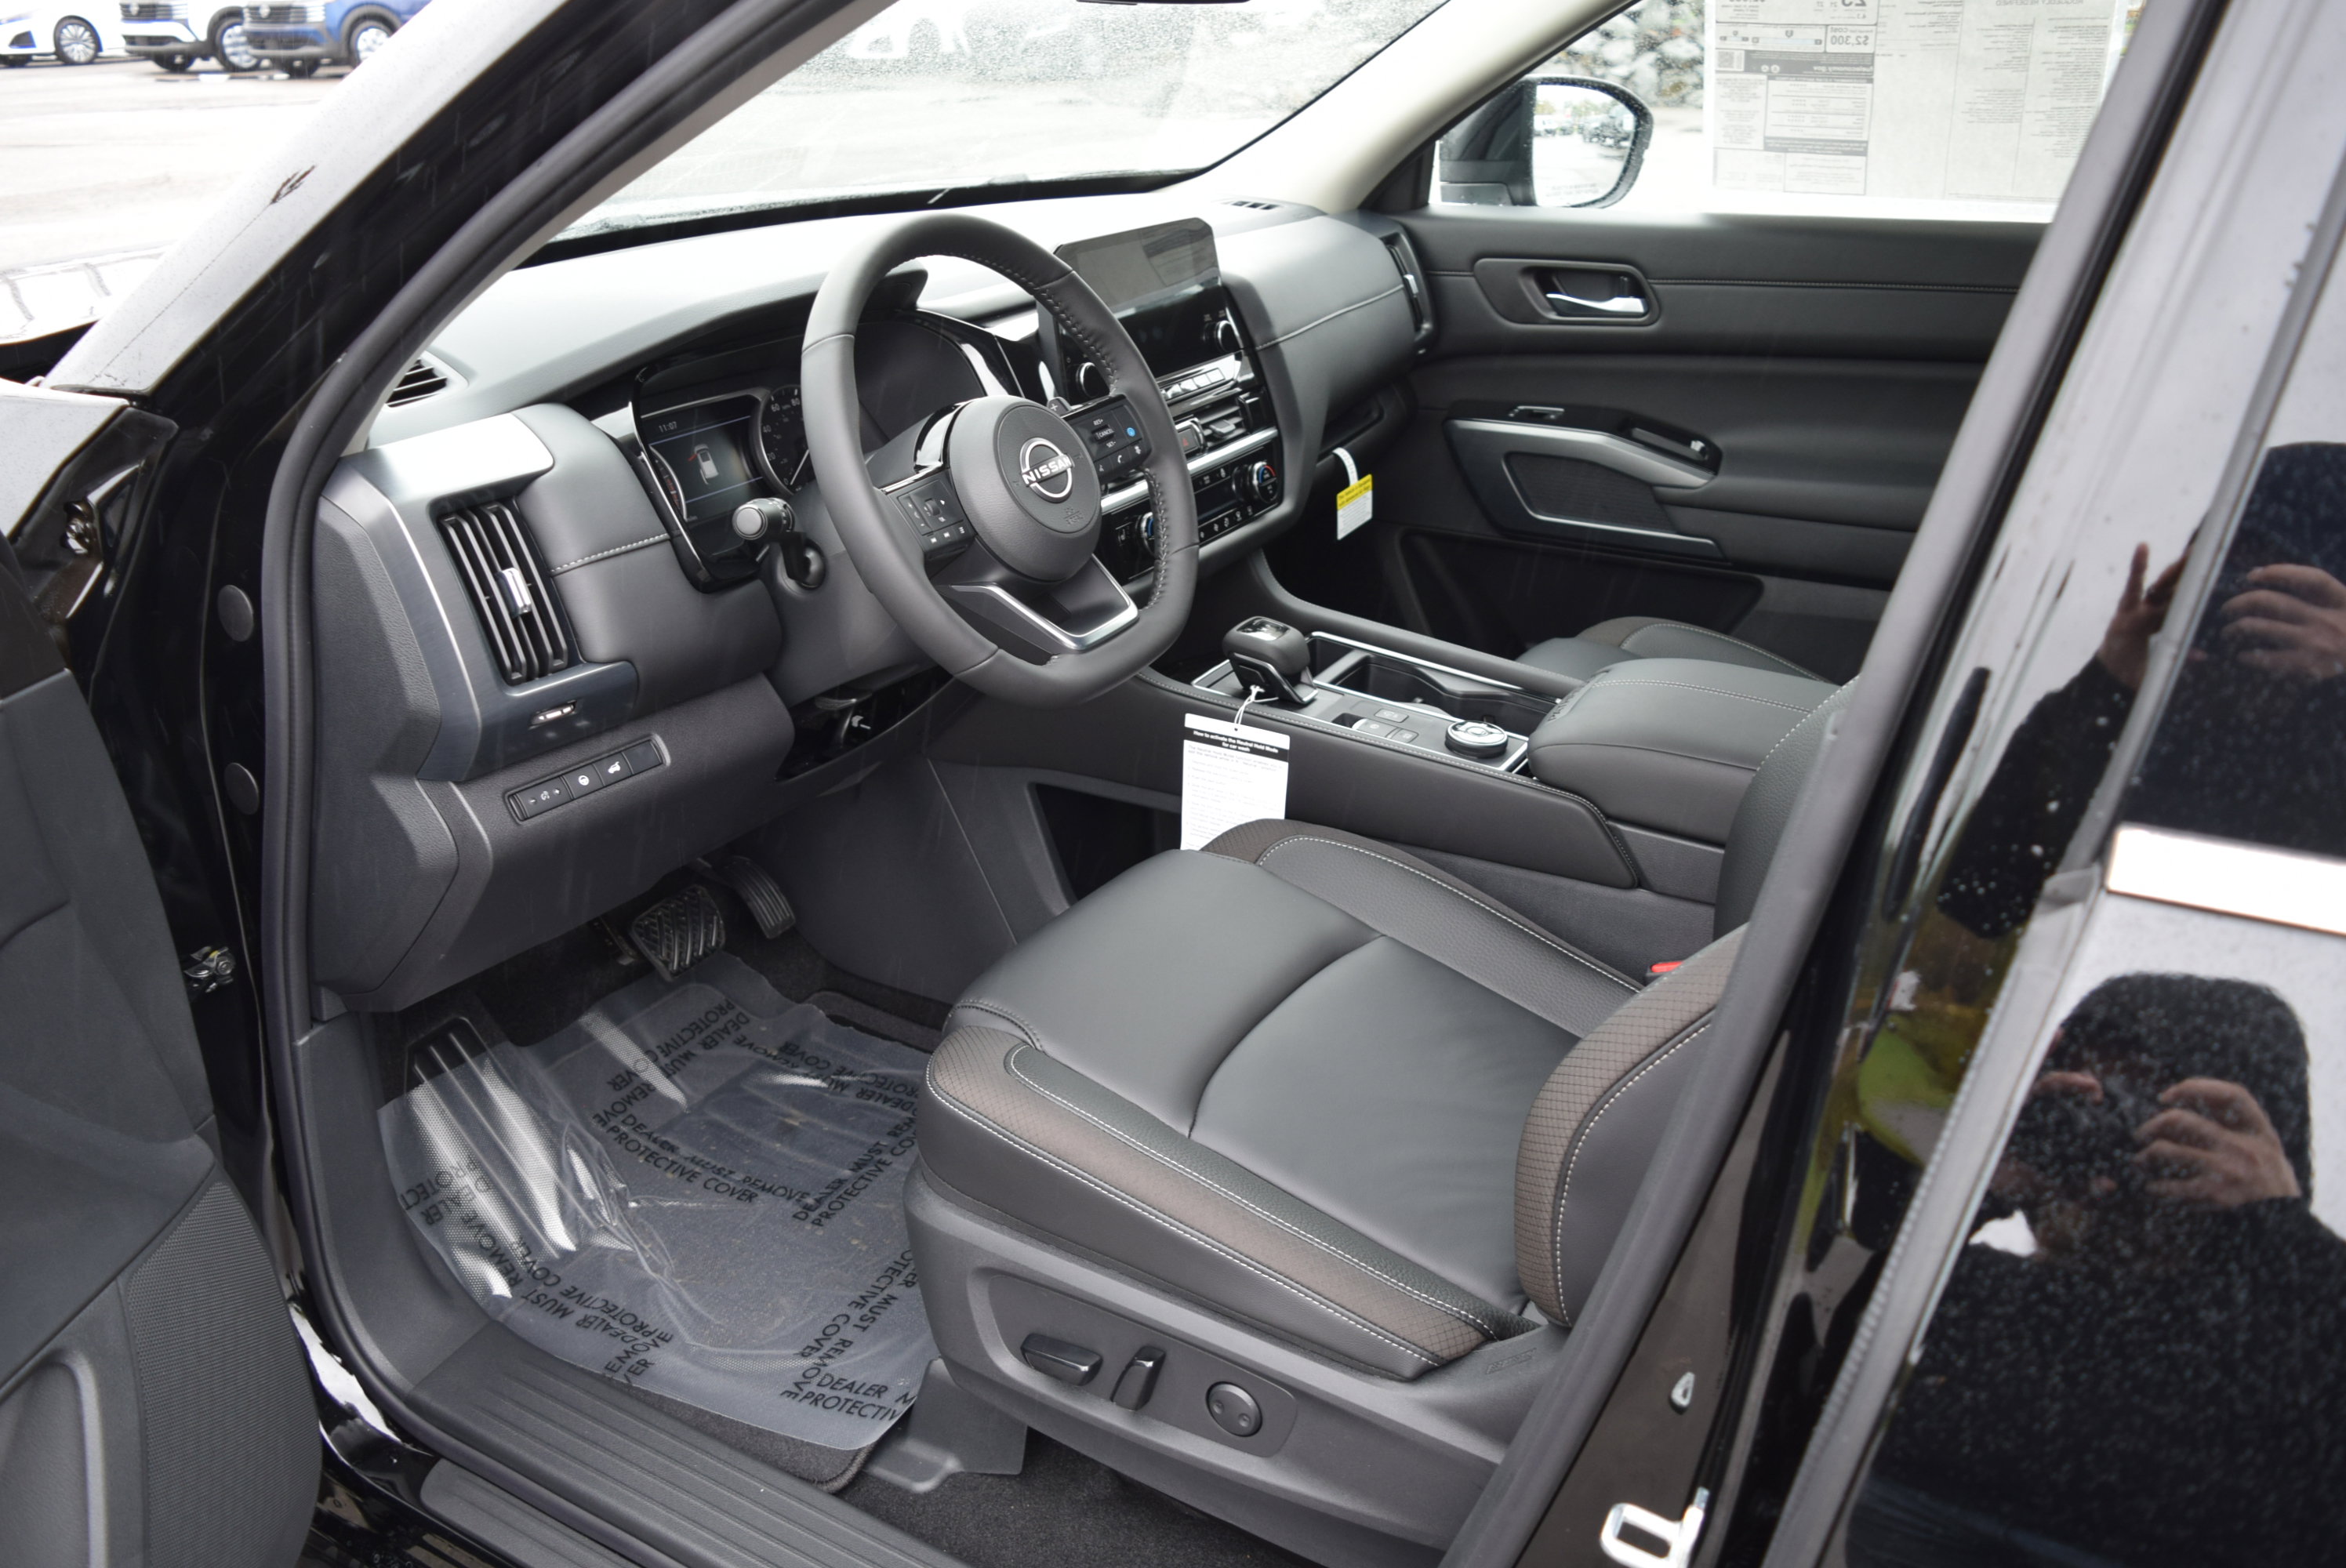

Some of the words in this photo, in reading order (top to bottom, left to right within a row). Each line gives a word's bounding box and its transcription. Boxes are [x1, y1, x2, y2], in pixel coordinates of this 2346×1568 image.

[771, 403, 780, 412] 60
[659, 422, 677, 433] 11:07
[1022, 457, 1071, 484] NISSAN
[1237, 739, 1254, 748] Neutral
[656, 998, 735, 1058] PROTECTIVE
[698, 1011, 750, 1051] DEALER
[607, 1049, 659, 1091] COVER
[779, 1040, 831, 1071] COVER
[592, 1082, 656, 1127] REMOVE
[855, 1087, 917, 1112] DEALER
[606, 1125, 703, 1183] PROTECTIVE
[703, 1178, 758, 1203] COVER
[621, 1114, 681, 1153] DEALER
[740, 1176, 811, 1203] REMOVE
[793, 1178, 848, 1221] DEALER
[848, 1141, 888, 1173] MUST
[811, 1159, 892, 1227] PROTECTIVE
[521, 1289, 575, 1319] MUST
[560, 1286, 659, 1338] PROTECTIVE
[853, 1294, 899, 1333] MUST
[576, 1314, 640, 1344] DEALER
[794, 1313, 851, 1358] COVER
[779, 1338, 854, 1399] REMOVE
[817, 1373, 889, 1399] DEALER
[798, 1391, 902, 1421] PROTECTIV
